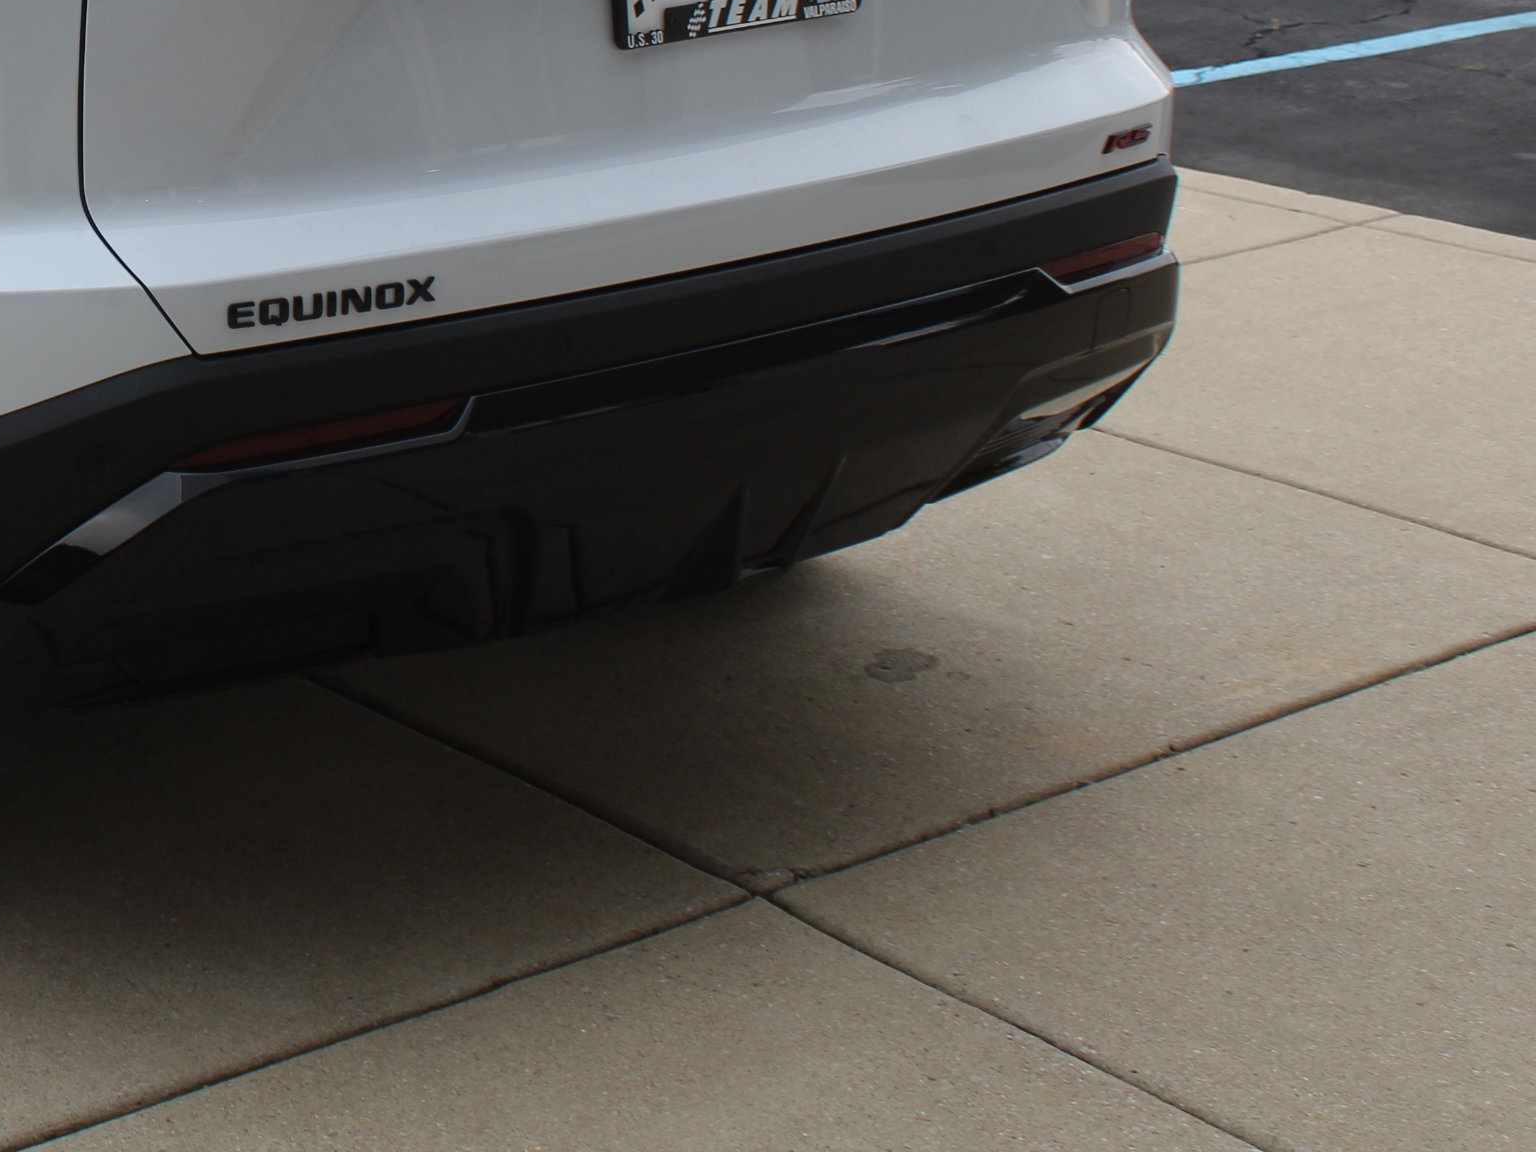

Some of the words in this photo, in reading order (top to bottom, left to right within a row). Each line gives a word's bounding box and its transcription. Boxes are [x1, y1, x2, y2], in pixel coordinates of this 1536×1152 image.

[627, 33, 649, 49] U.S.
[650, 29, 664, 45] 30
[1100, 122, 1153, 155] RS
[226, 275, 437, 330] EQUINOX
